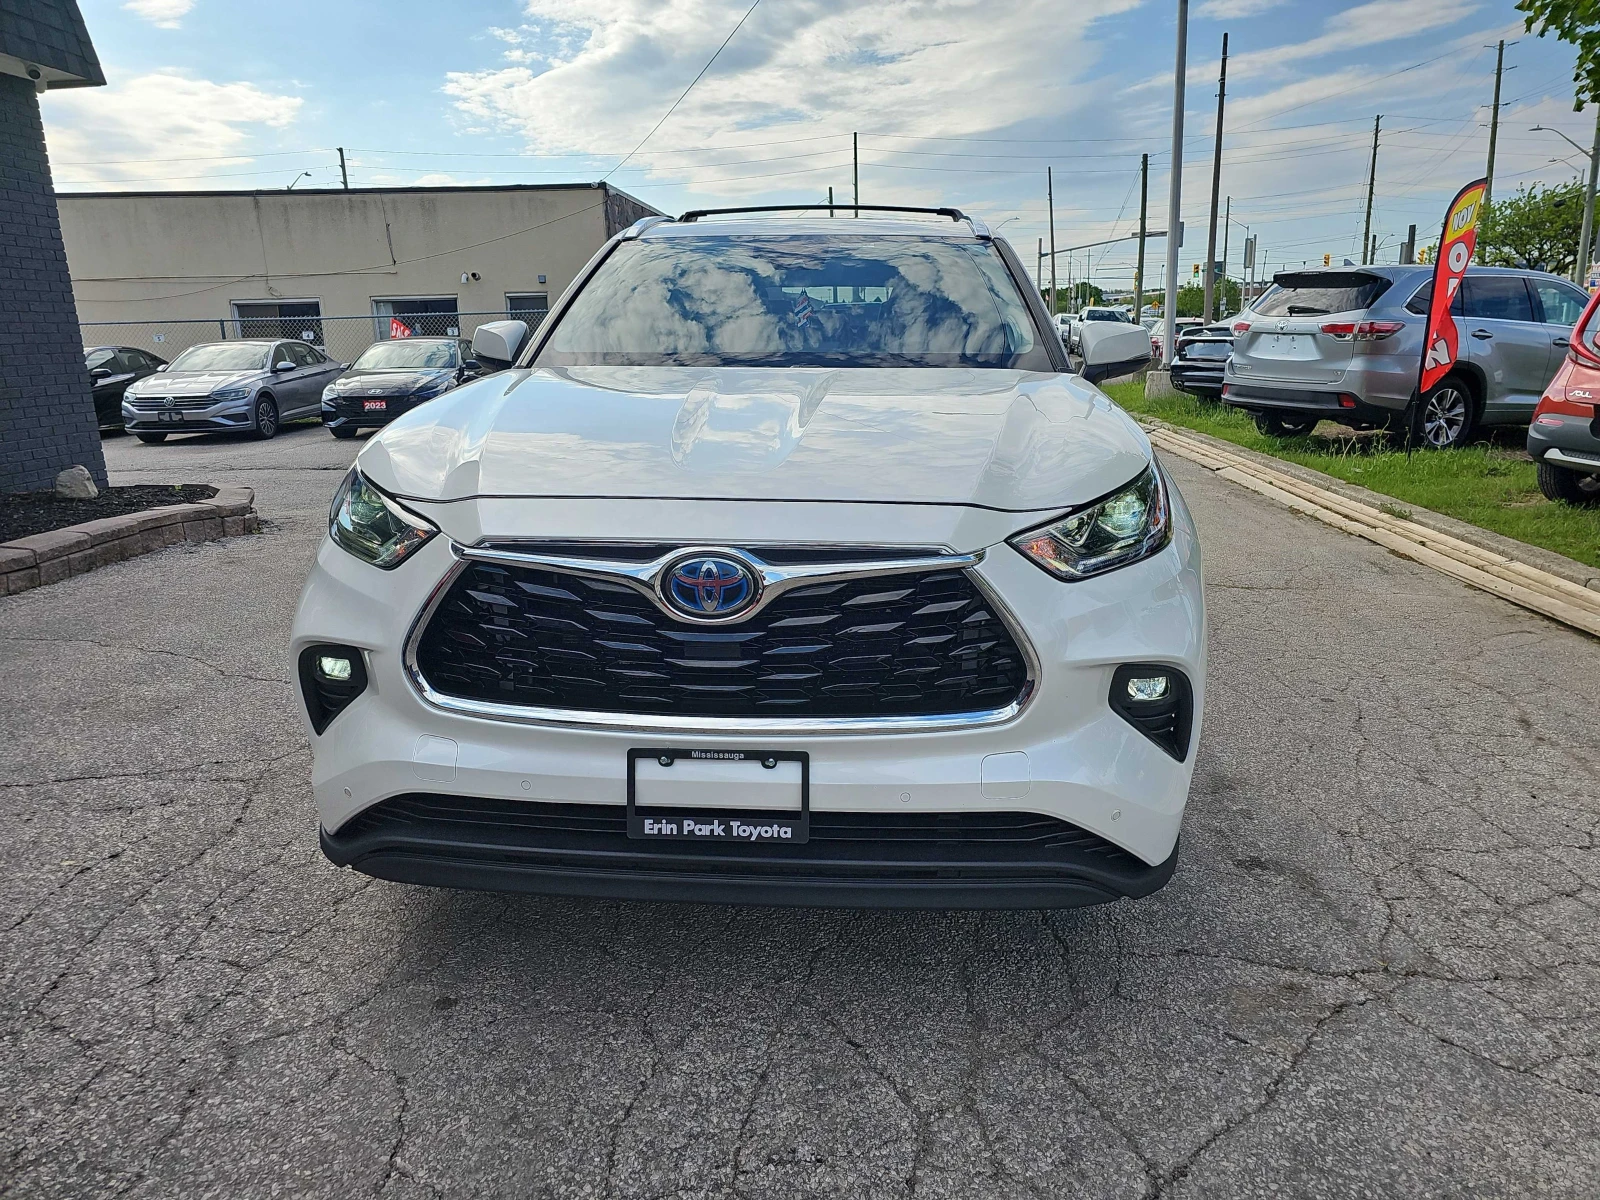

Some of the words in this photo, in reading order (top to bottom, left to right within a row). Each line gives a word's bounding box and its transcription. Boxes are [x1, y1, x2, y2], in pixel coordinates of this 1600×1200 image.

[692, 751, 745, 760] Mississauga
[644, 819, 677, 835] Erin
[683, 820, 725, 836] Park
[730, 821, 792, 841] Toyota
